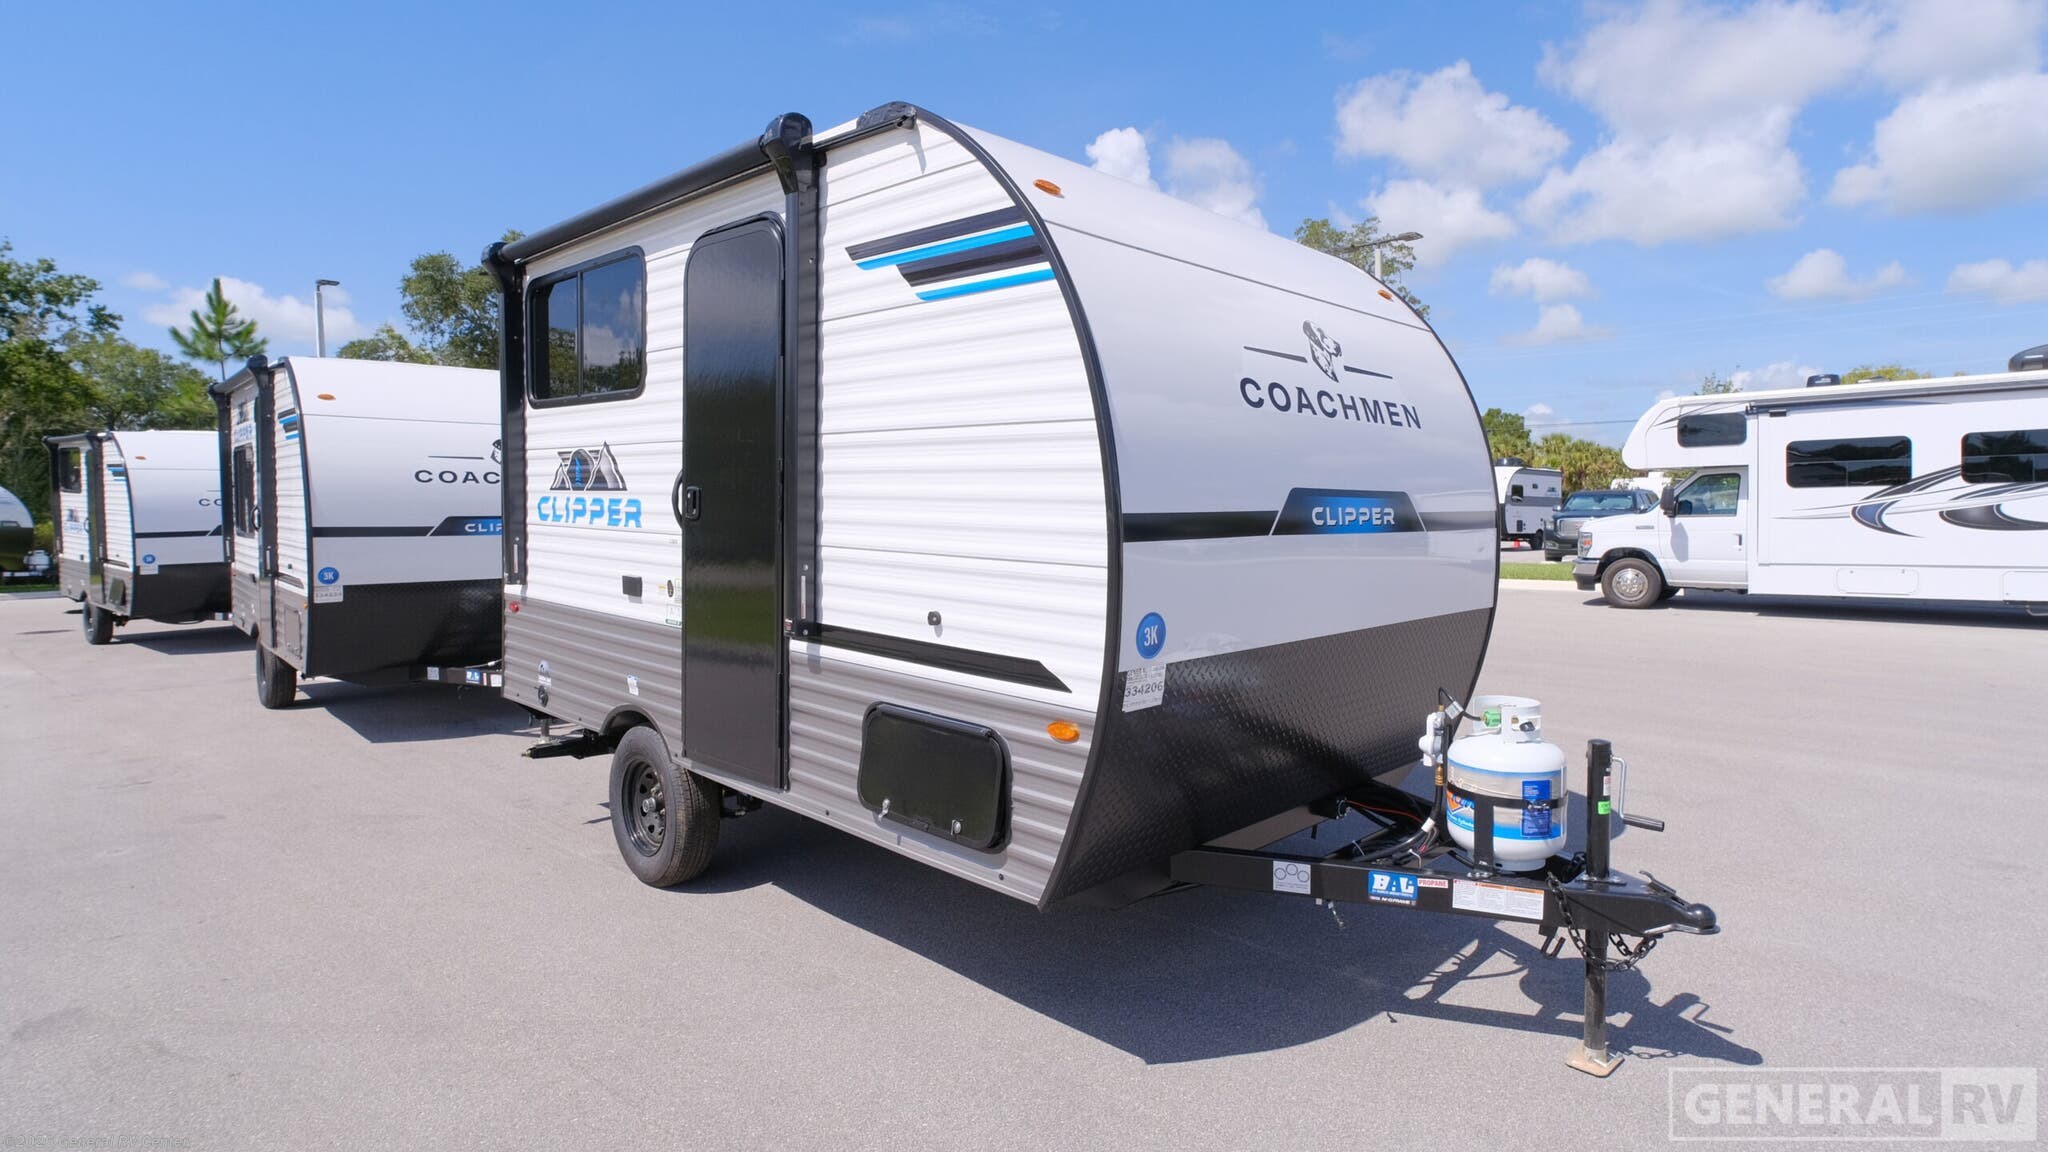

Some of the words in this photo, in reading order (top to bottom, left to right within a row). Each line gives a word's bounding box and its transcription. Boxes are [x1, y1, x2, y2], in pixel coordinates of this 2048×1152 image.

[1240, 377, 1422, 430] COACHMEN
[414, 470, 501, 484] COAC
[537, 495, 642, 528] CLIPPER
[1311, 506, 1396, 527] CLIPPER
[1143, 624, 1159, 647] 3K
[1372, 873, 1415, 894] BAL
[1418, 878, 1447, 888] PROPANE
